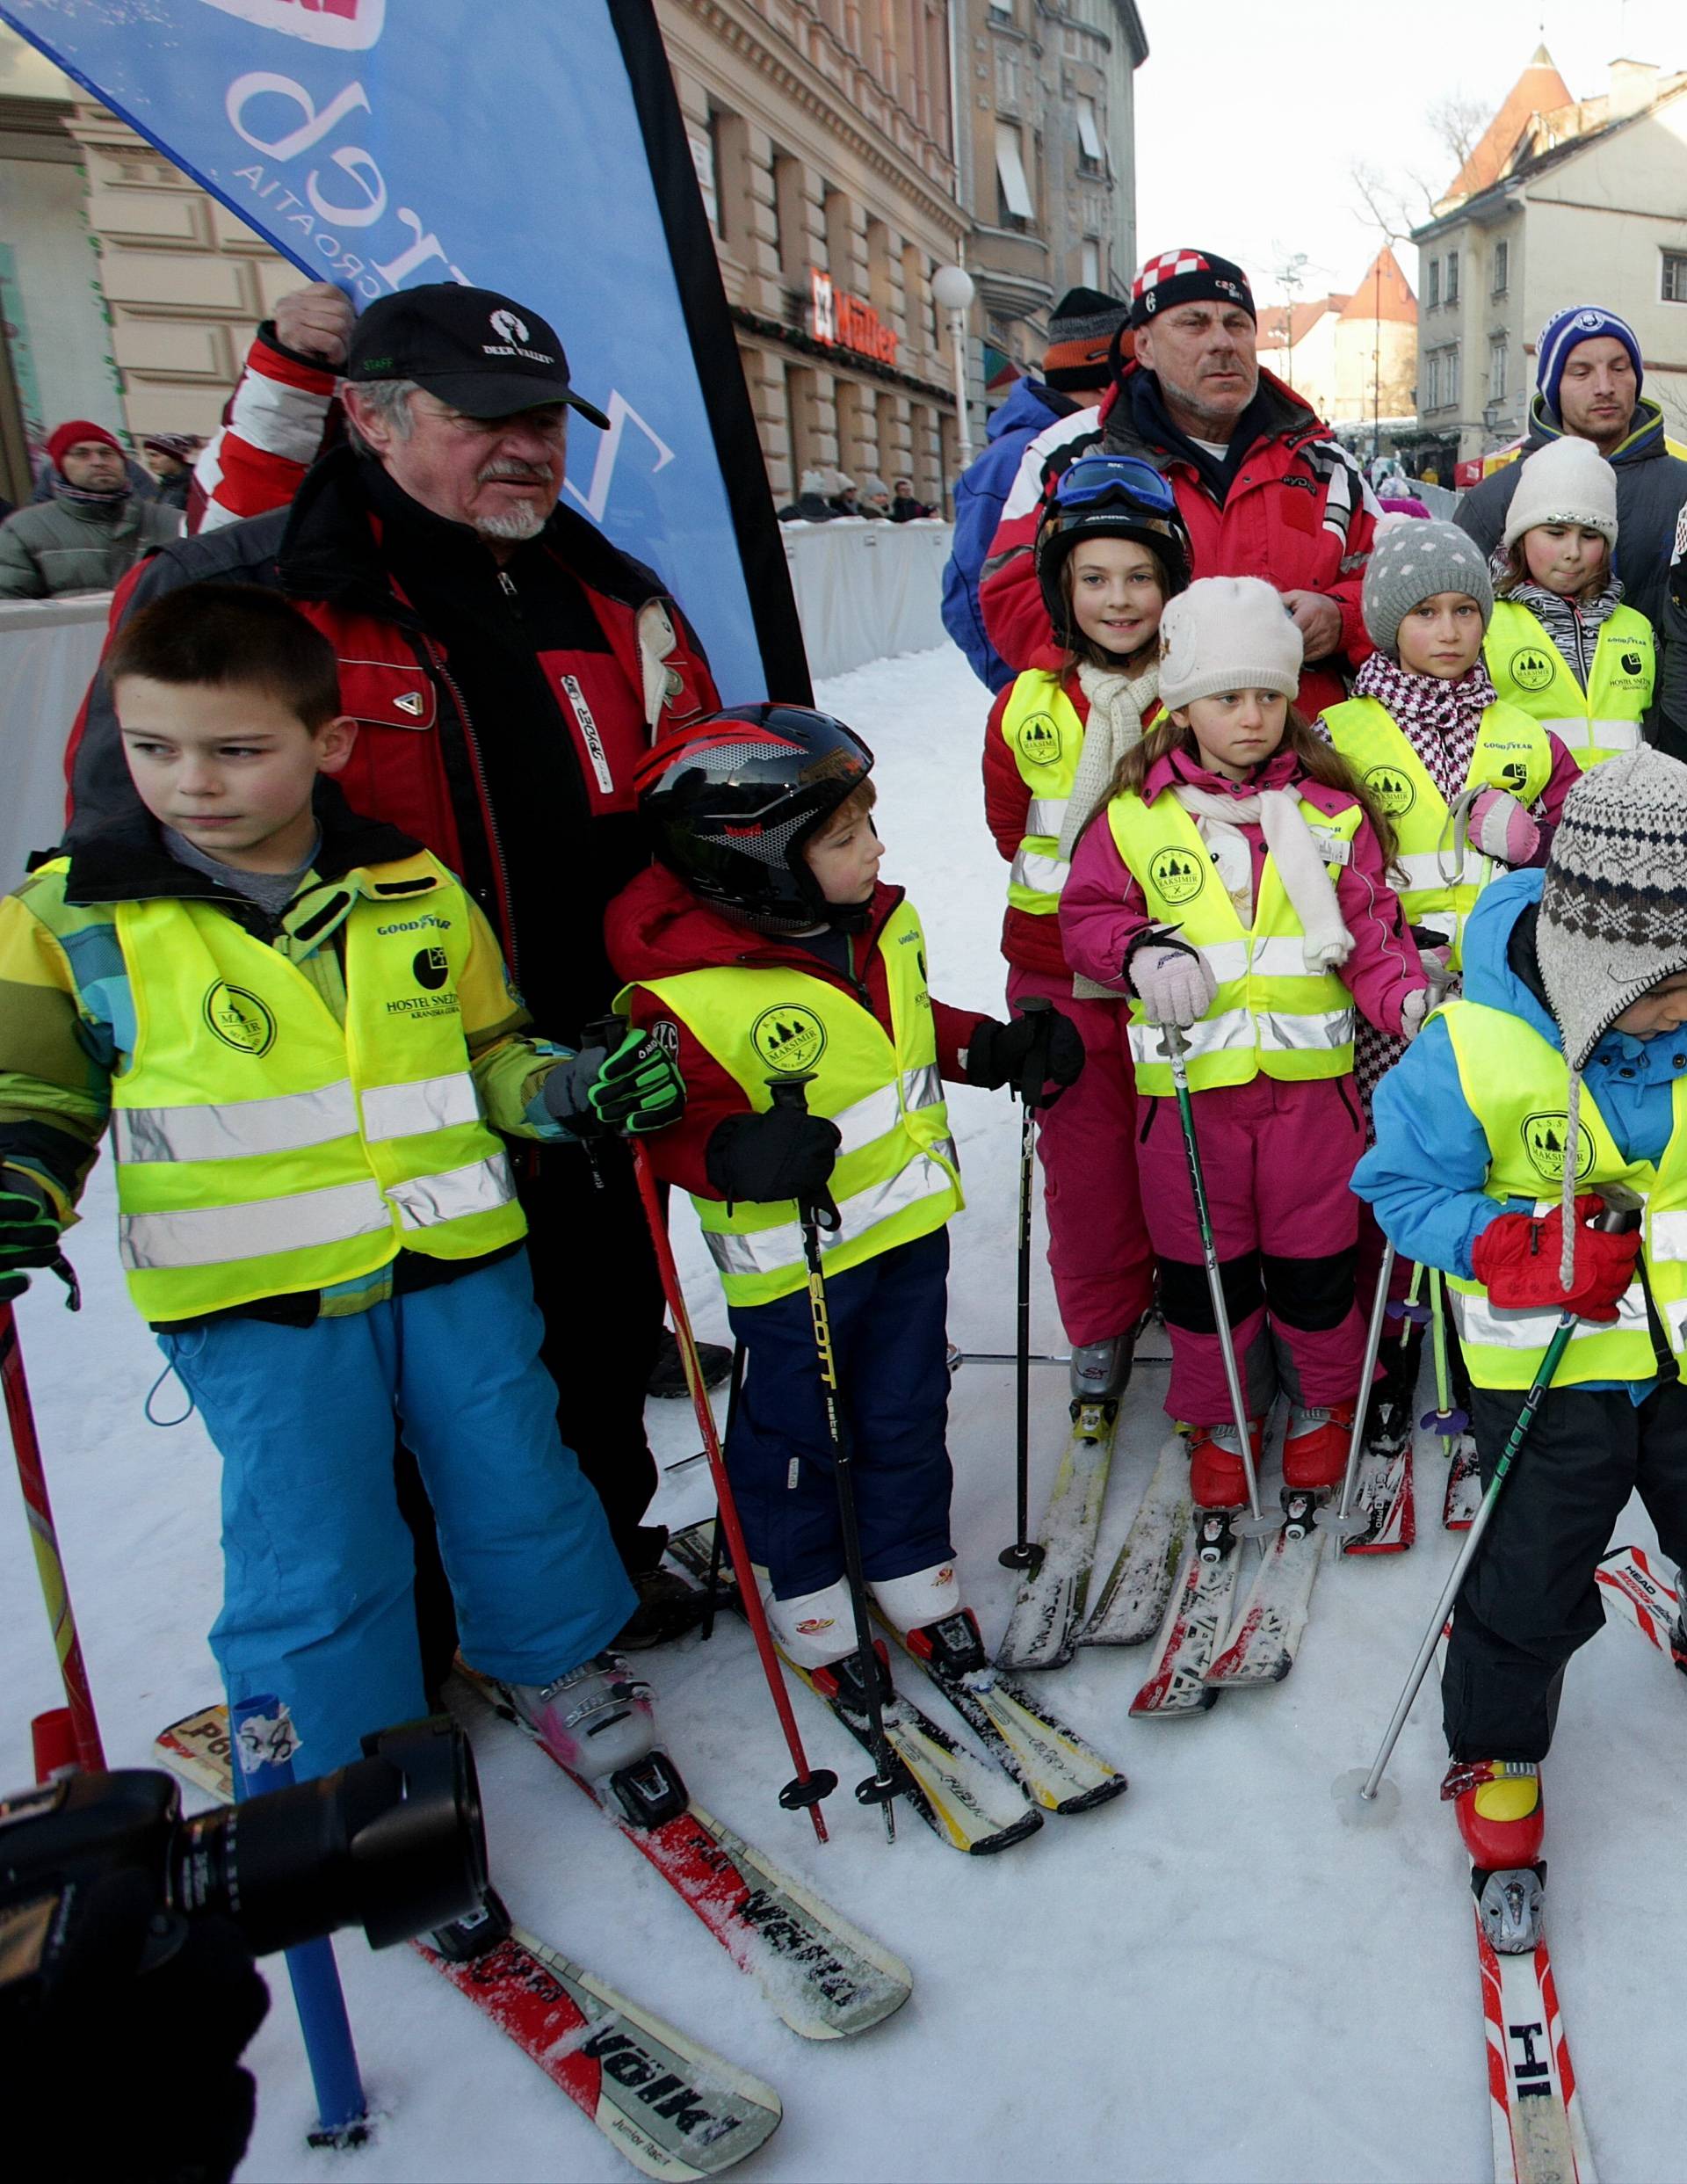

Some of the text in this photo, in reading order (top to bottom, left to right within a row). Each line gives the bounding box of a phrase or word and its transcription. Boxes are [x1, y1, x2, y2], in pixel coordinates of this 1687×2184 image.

[363, 358, 394, 372] STAFF
[481, 345, 517, 356] DEER
[387, 997, 430, 1012] HOSTEL
[769, 1030, 818, 1061] MAKSIMIR
[807, 1272, 837, 1390] SCOTT
[826, 1397, 838, 1442] master
[1375, 1508, 1384, 1528] PRO
[1625, 1564, 1657, 1595] HEAD
[612, 2118, 644, 2150] Junior
